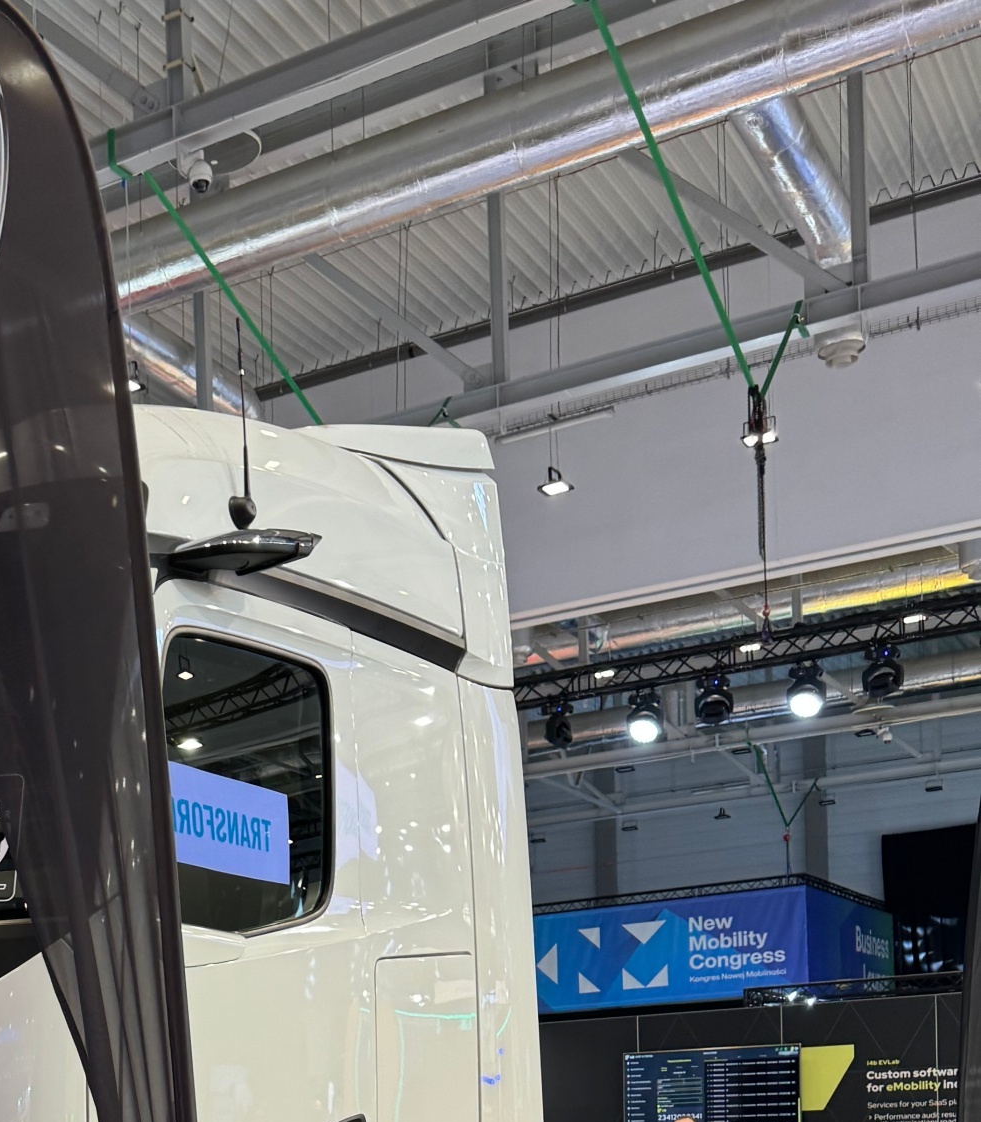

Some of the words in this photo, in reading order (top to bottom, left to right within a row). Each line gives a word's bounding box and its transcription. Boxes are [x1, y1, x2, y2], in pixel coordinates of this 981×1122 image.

[688, 915, 734, 933] New
[689, 930, 768, 952] Mobility
[855, 925, 889, 959] Business
[689, 949, 786, 970] Congress
[689, 974, 720, 983] Kongres
[721, 971, 745, 980] Nowej
[866, 1069, 911, 1080] Custom
[912, 1067, 959, 1078] softwar
[866, 1082, 885, 1093] for
[886, 1080, 941, 1092] eMobility
[867, 1101, 898, 1109] Services
[899, 1100, 909, 1108] for
[910, 1100, 927, 1109] your
[874, 1113, 921, 1121] Performance
